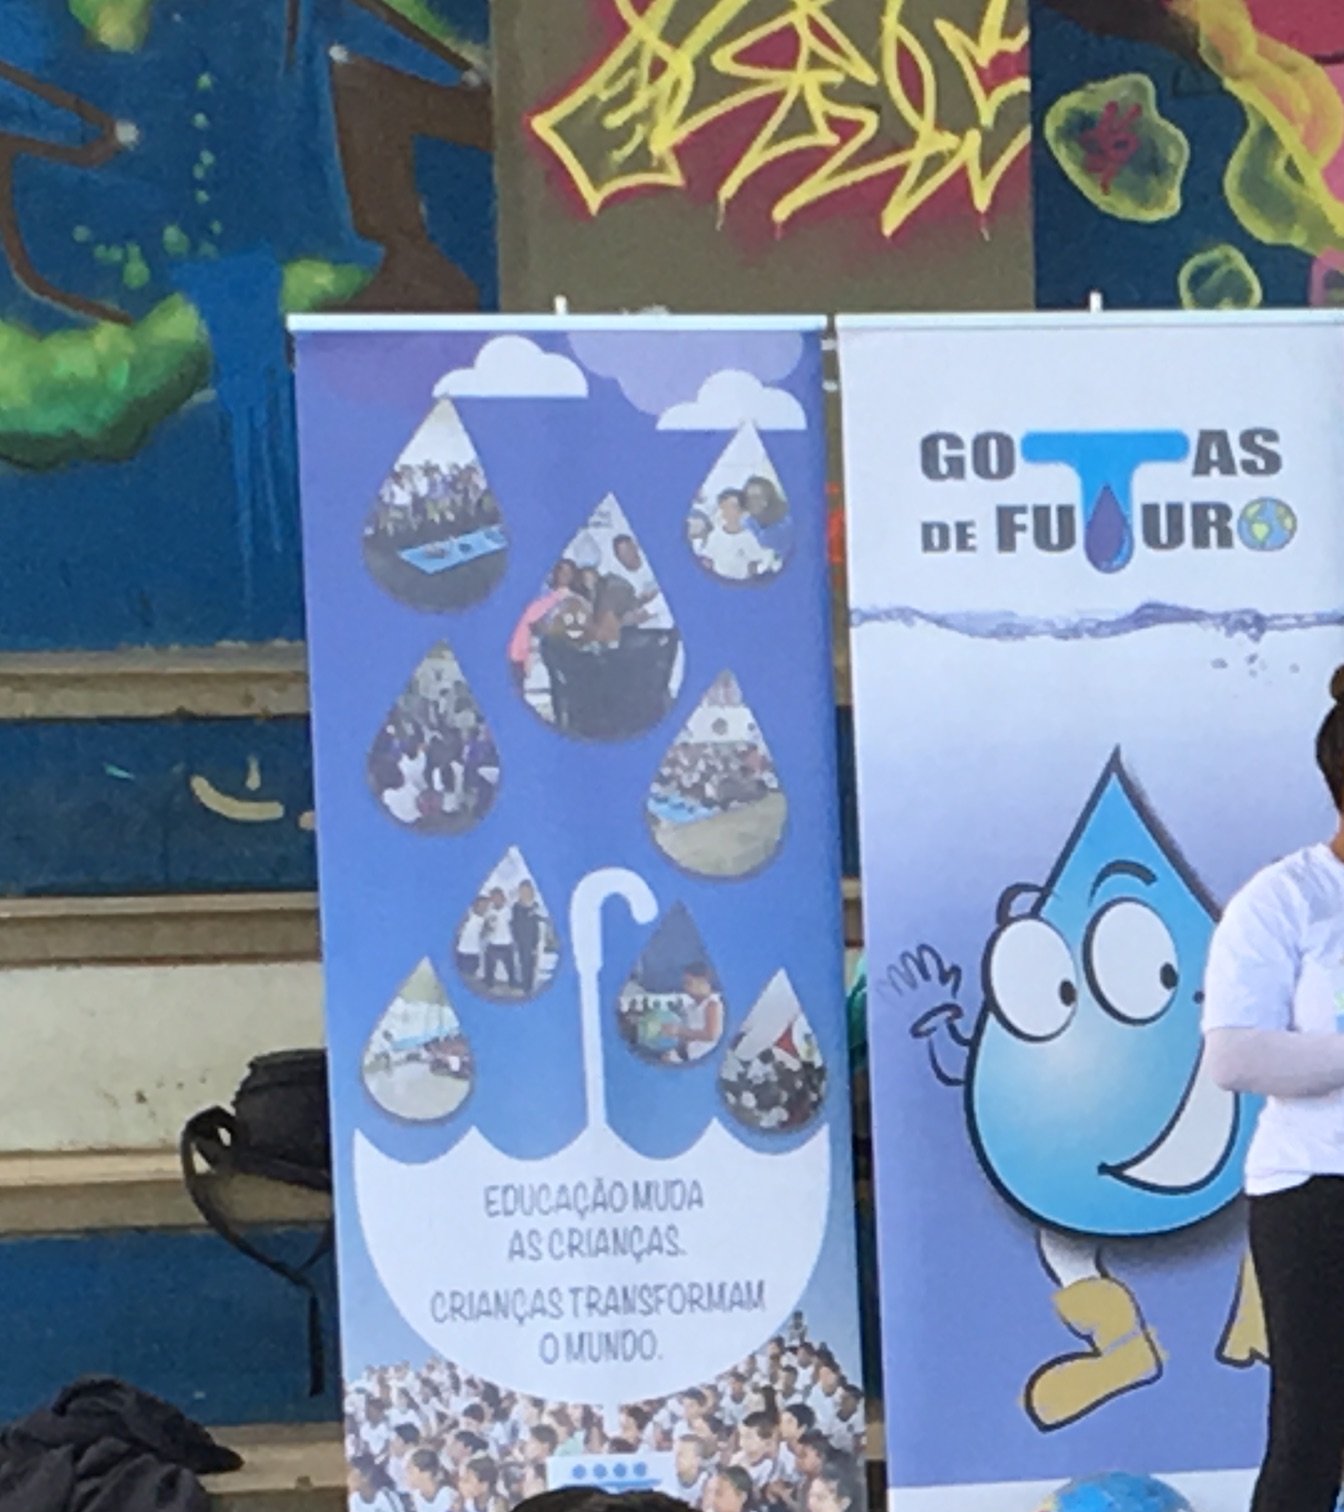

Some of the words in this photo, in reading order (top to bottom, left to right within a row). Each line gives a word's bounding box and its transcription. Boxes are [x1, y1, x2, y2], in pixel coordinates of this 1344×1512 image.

[919, 427, 1284, 482] GOTAS
[921, 520, 977, 554] DE
[484, 1176, 628, 1220] EDUCAÇÃO
[632, 1179, 704, 1211] MUDA
[508, 1228, 542, 1262] AS
[549, 1223, 688, 1263] CRIANÇAS.
[431, 1286, 564, 1325] CRIANÇAS
[568, 1279, 766, 1318] TRANSFORMAM
[538, 1331, 559, 1365] O
[565, 1328, 663, 1364] MUNDO.
